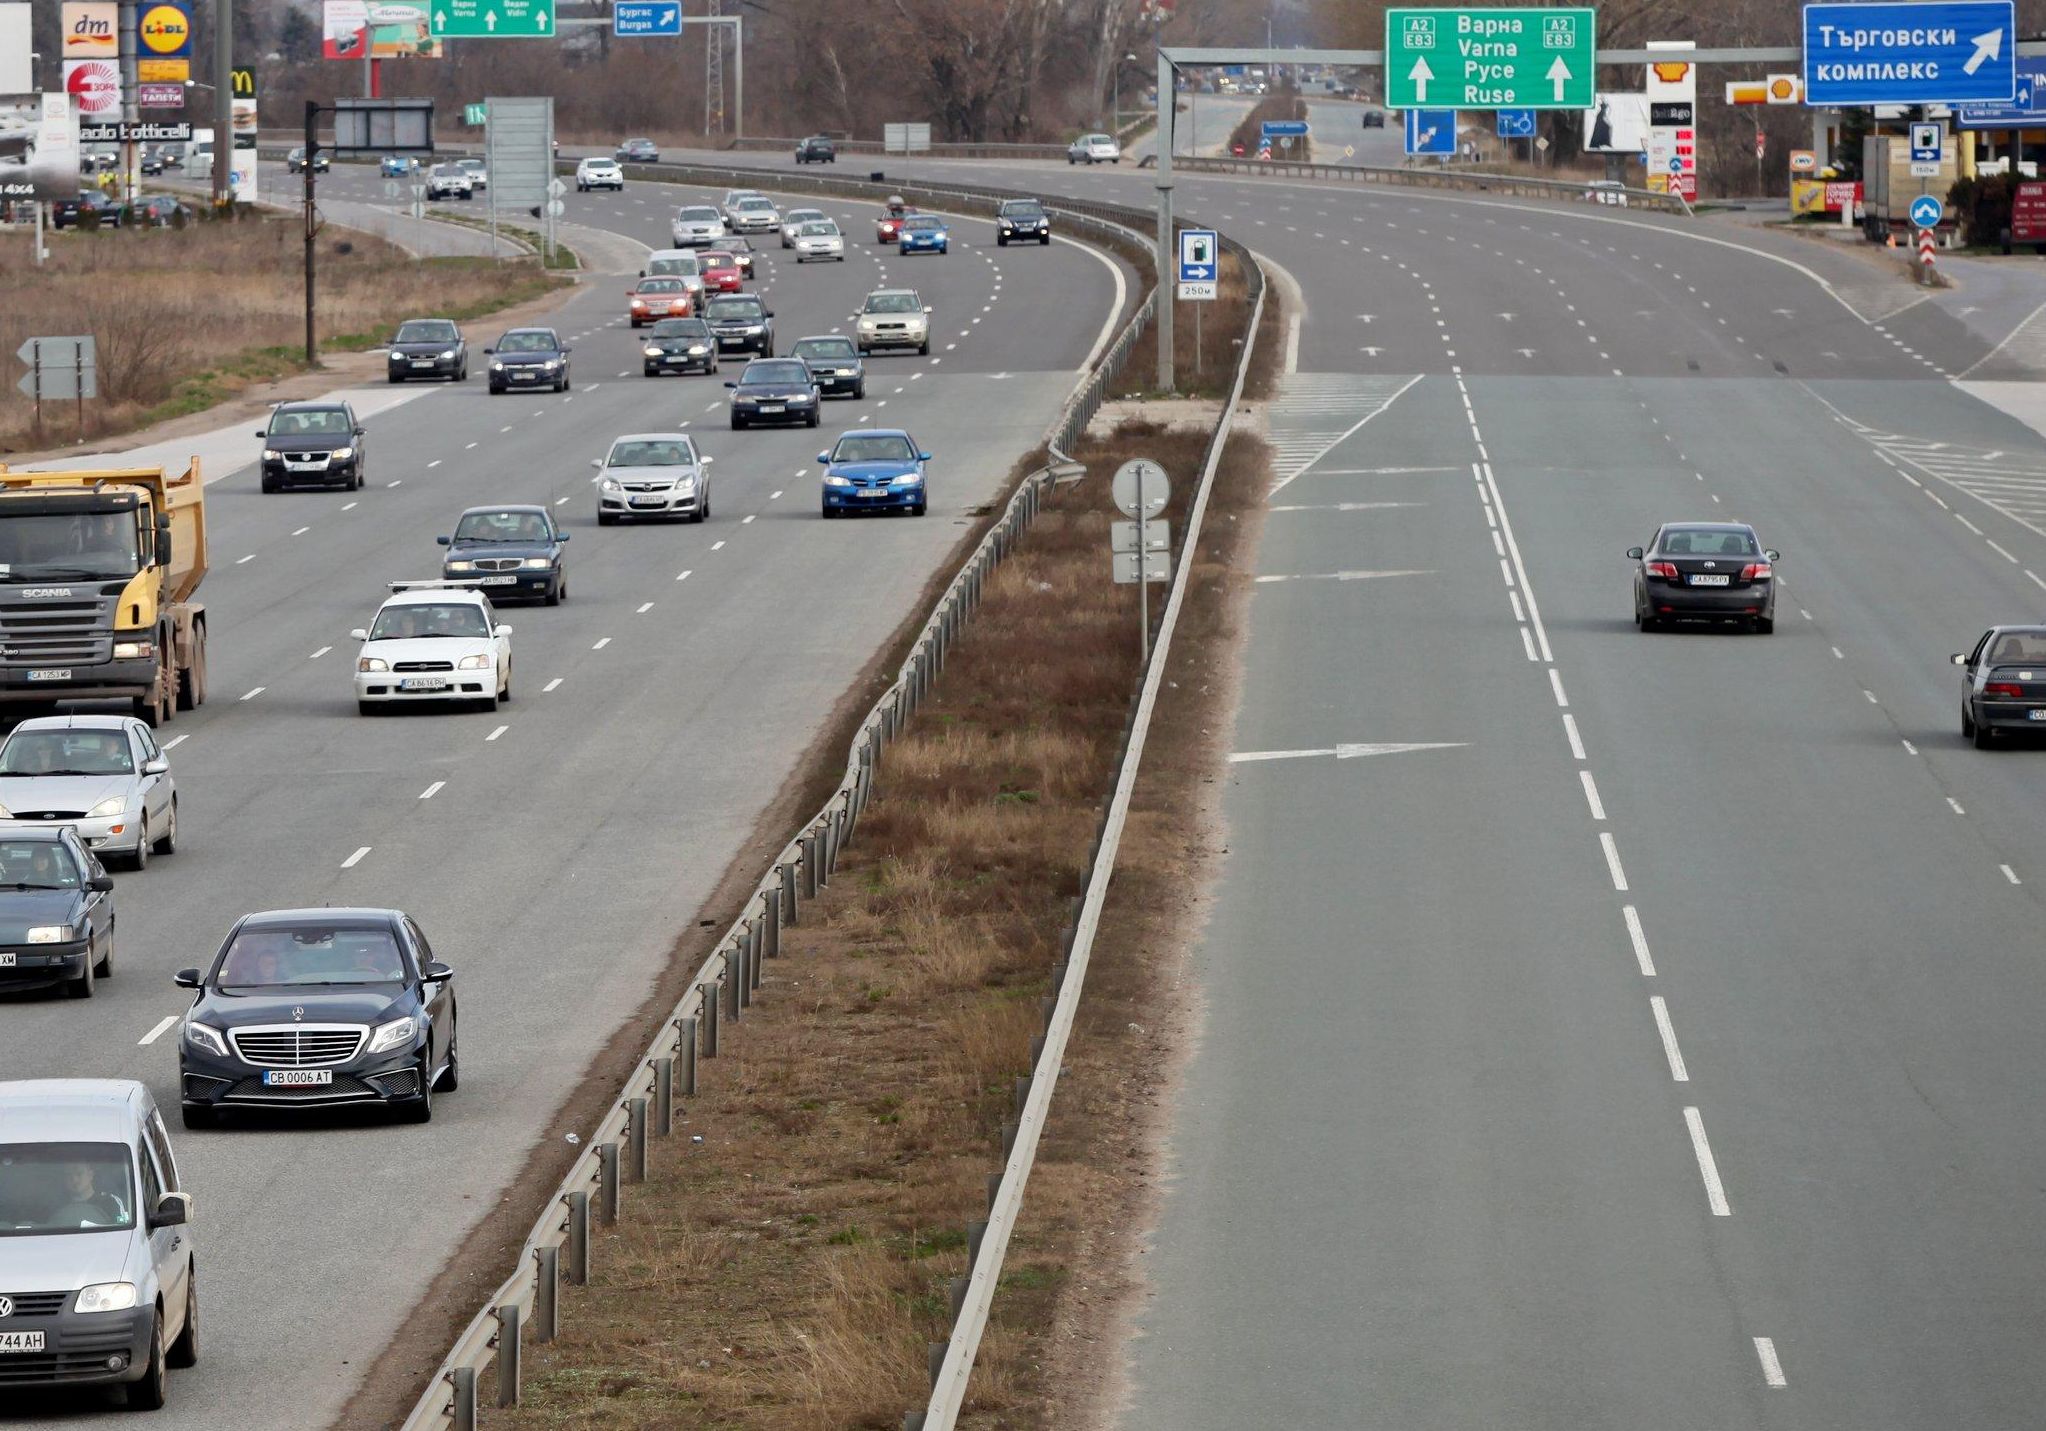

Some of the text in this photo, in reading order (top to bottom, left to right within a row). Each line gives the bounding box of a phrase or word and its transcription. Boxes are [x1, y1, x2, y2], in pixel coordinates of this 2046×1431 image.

[506, 9, 527, 17] Vidin
[619, 8, 652, 17] Бургас
[75, 15, 109, 34] dm
[619, 20, 652, 30] Burgas
[1410, 19, 1429, 31] A2
[1457, 15, 1523, 37] Варна
[1550, 18, 1569, 31] A2
[1406, 33, 1433, 47] E83
[1545, 33, 1573, 46] E83
[1818, 25, 1956, 52] Търговски
[1457, 38, 1518, 57] Varna
[1465, 60, 1515, 83] Русе
[1817, 61, 1940, 82] комплекс
[142, 93, 182, 103] ТАПЕТИ
[1465, 86, 1515, 104] Ruse
[22, 588, 72, 598] SCANIA
[1, 954, 15, 965] XM
[270, 1071, 330, 1084] CB 0006 AT
[24, 1334, 42, 1348] AH
